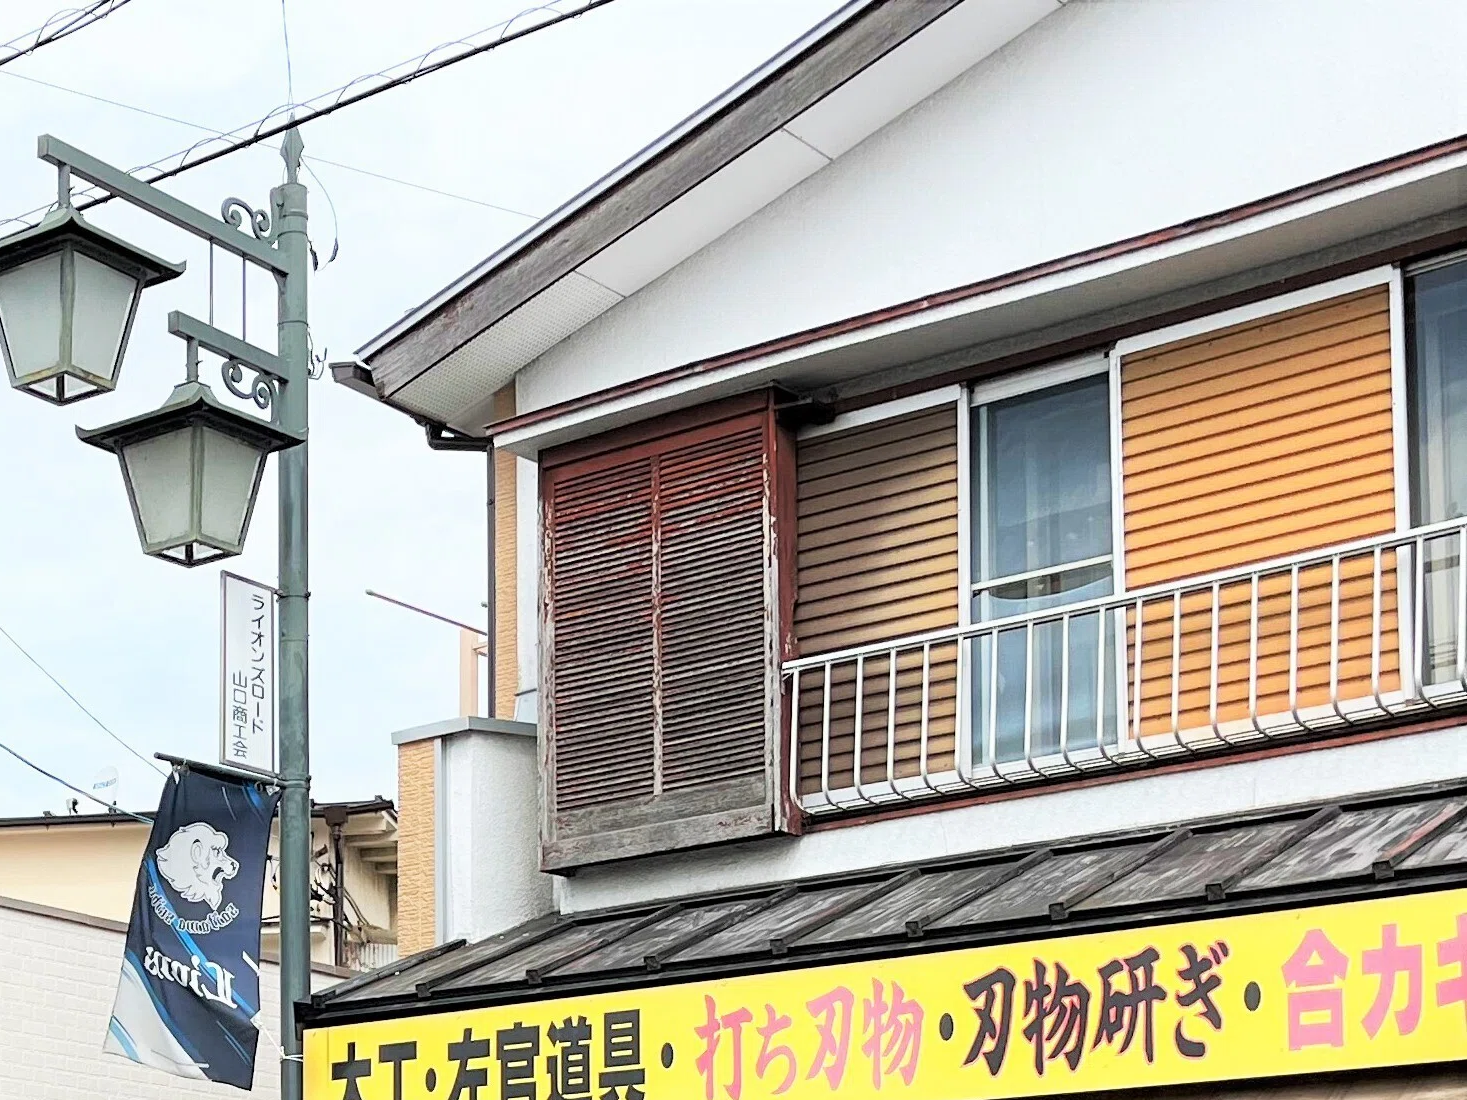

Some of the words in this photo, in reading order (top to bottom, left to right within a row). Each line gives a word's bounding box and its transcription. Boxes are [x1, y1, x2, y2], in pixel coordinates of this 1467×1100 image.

[233, 670, 248, 759] 山口商工会
[251, 594, 265, 734] ライオンズロード
